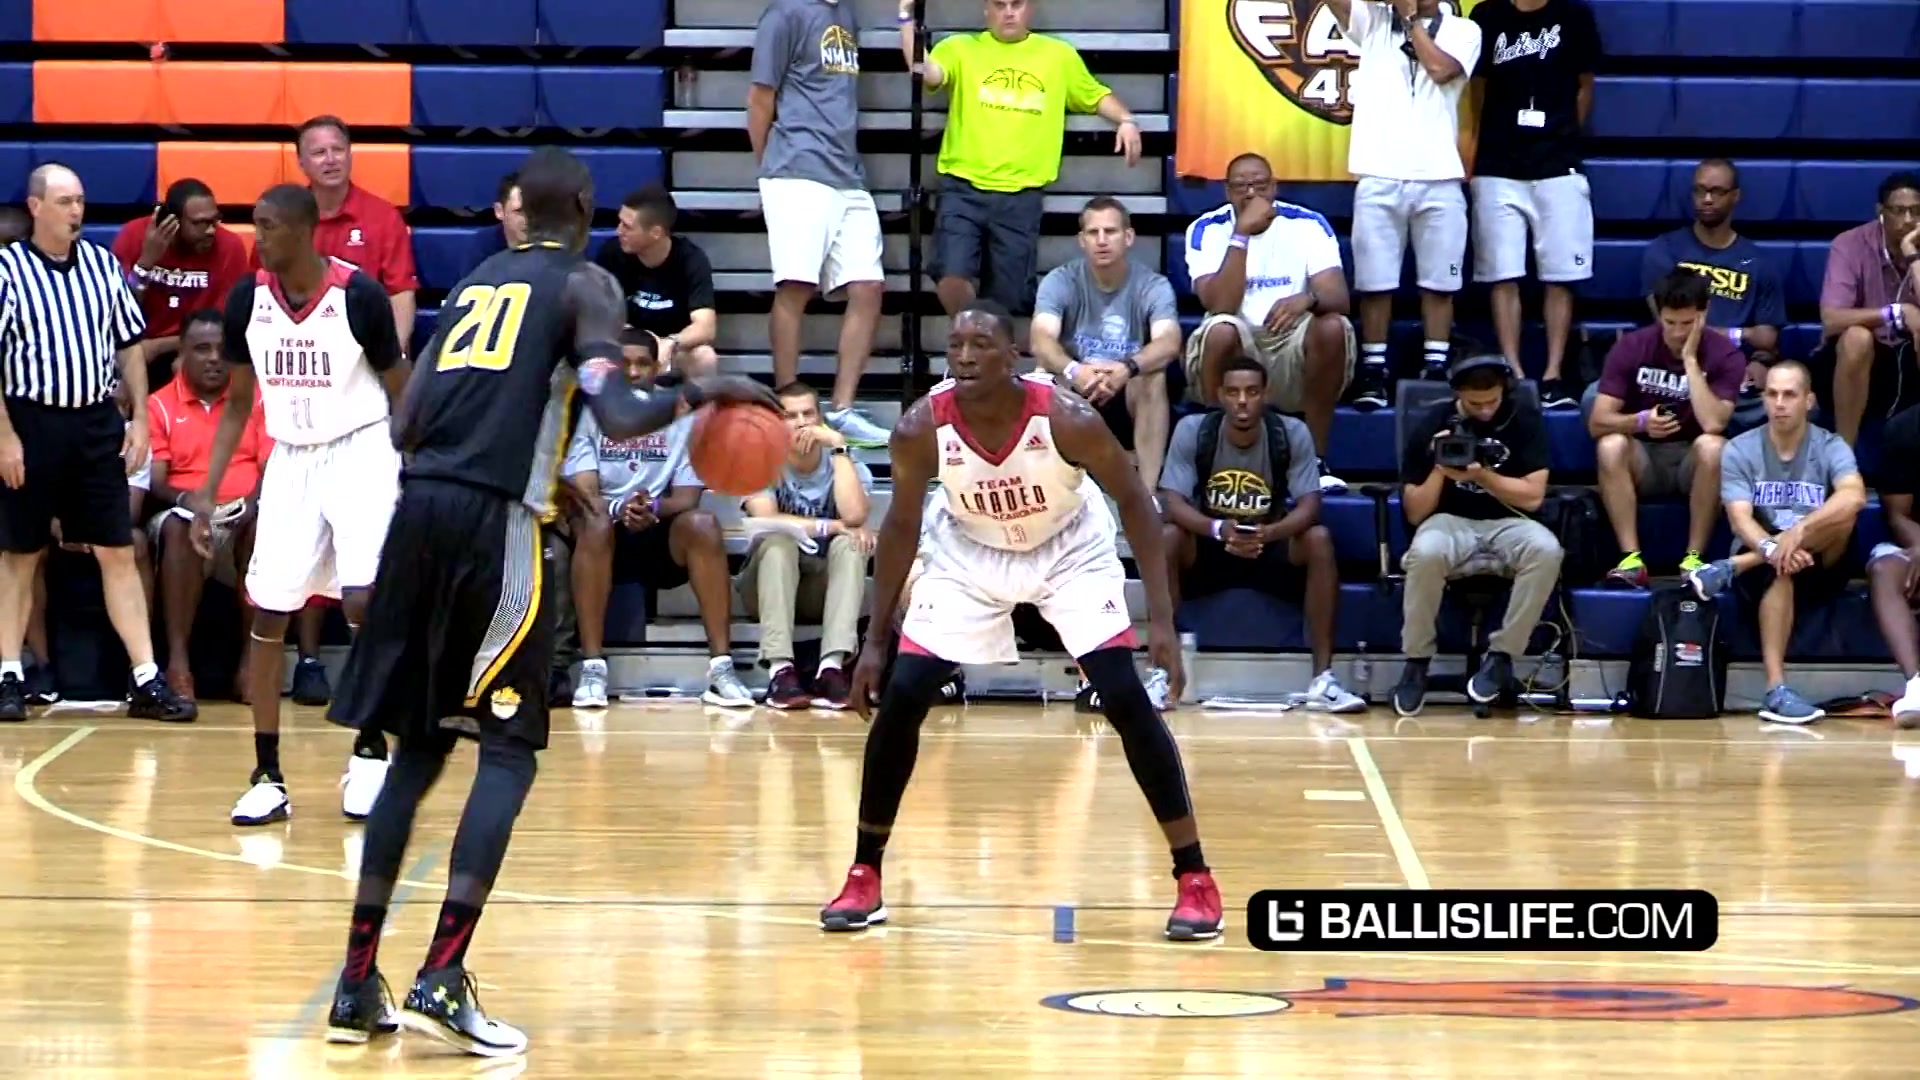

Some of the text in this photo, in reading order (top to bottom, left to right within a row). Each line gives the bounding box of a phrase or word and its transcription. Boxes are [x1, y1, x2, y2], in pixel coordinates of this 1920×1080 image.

[1230, 0, 1361, 63] FA
[1300, 67, 1354, 106] 4
[167, 271, 209, 288] STATE
[1678, 262, 1749, 292] TSU
[436, 283, 532, 372] 20
[280, 338, 315, 347] TEAM
[265, 350, 331, 375] LOADED
[1636, 366, 1708, 391] COLGA
[976, 476, 1022, 490] TEAM
[1754, 481, 1824, 507] HIGH POINT
[960, 485, 1046, 514] LOADED
